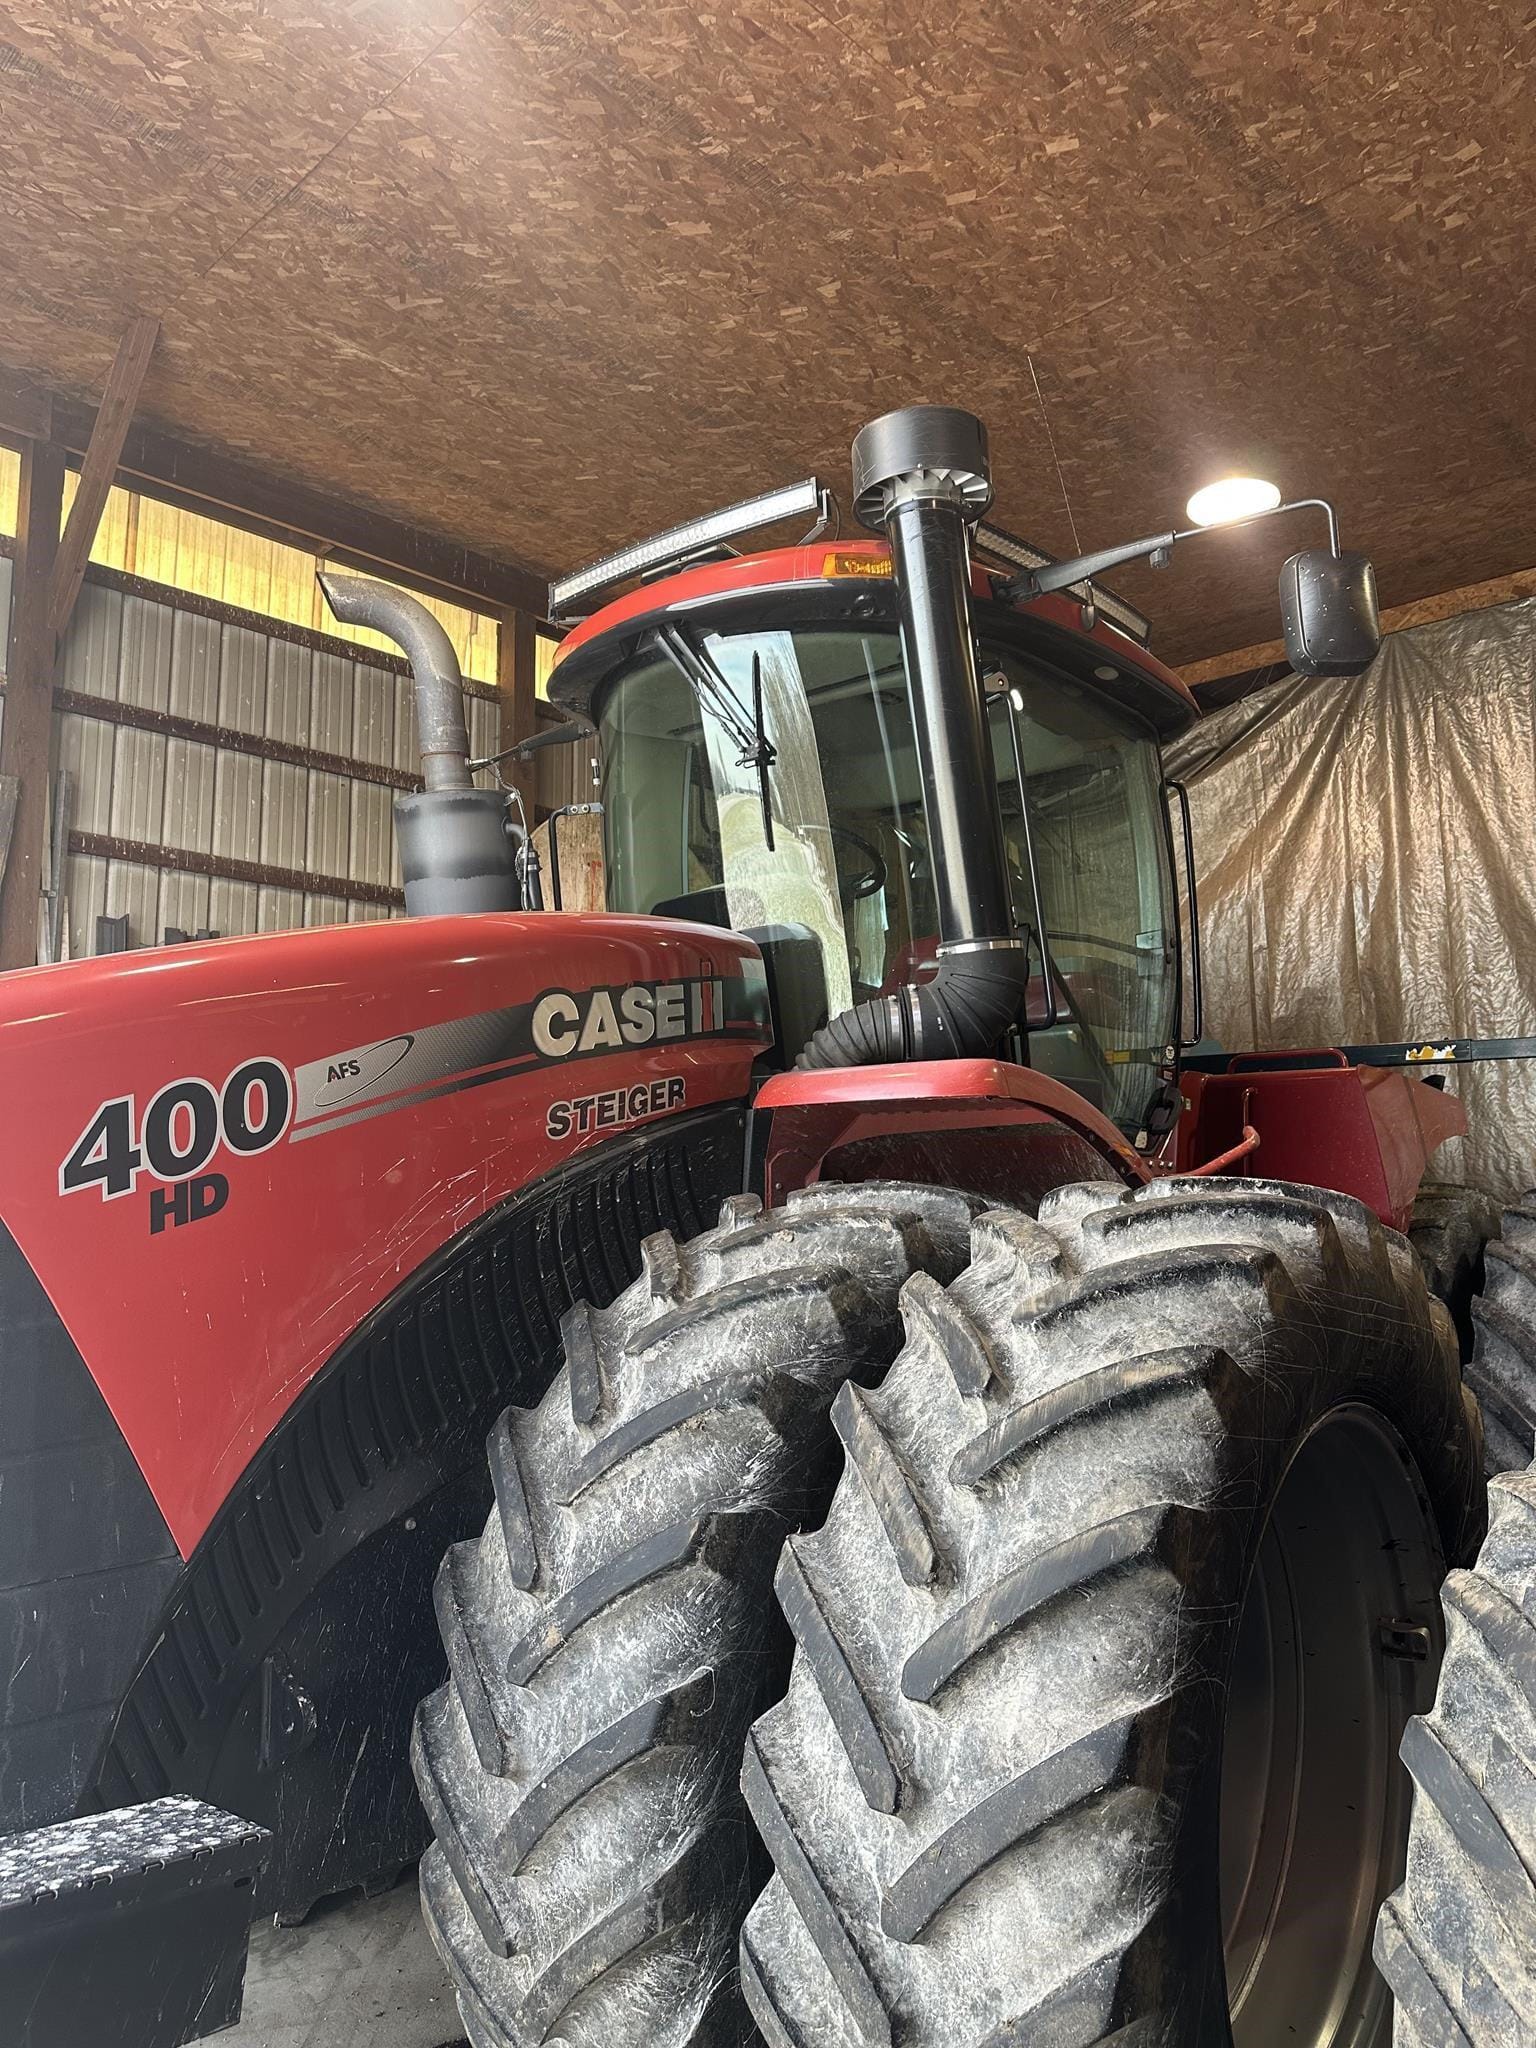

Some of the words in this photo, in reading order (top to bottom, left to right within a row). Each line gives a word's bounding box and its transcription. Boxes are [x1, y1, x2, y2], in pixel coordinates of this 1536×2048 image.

[327, 1060, 360, 1083] AFS
[58, 1056, 292, 1202] 400
[546, 1076, 685, 1140] STEIGER
[150, 1173, 230, 1235] HD
